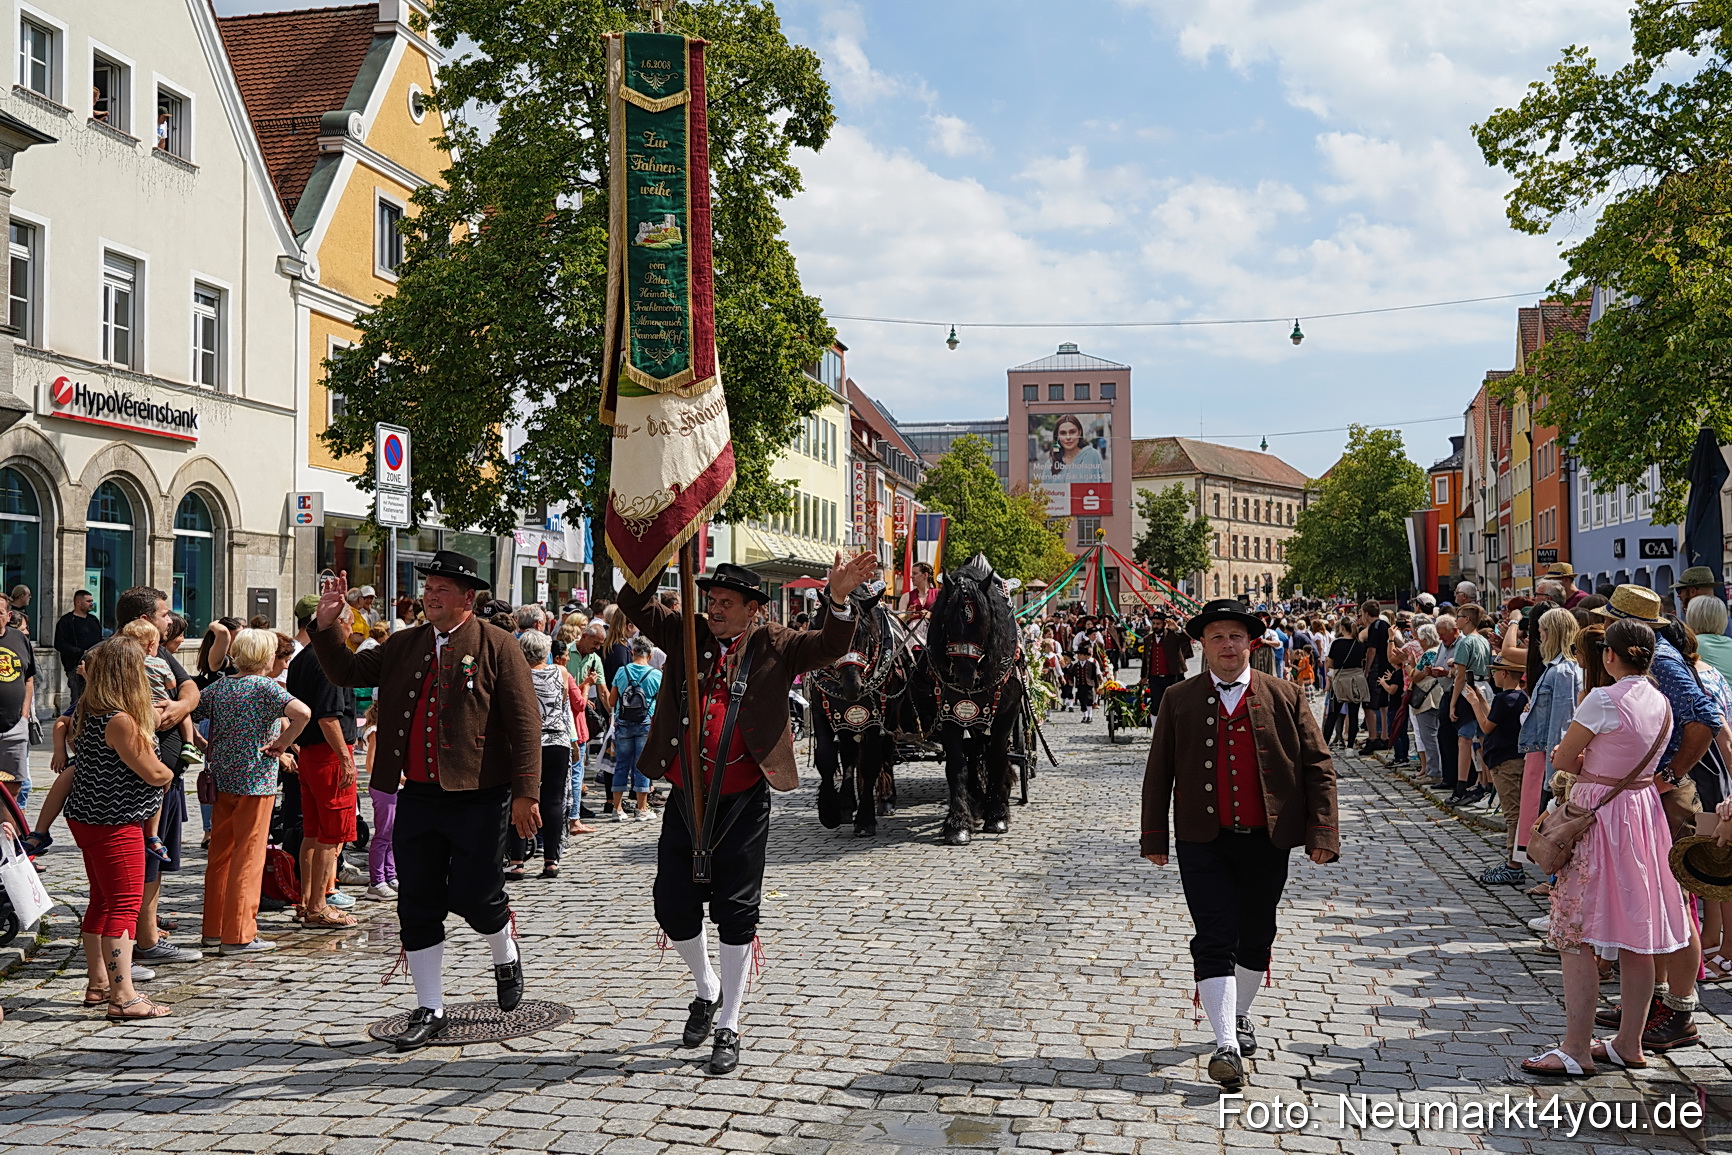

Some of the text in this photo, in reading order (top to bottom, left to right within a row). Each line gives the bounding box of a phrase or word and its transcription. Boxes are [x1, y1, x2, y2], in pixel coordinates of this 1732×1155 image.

[643, 130, 669, 148] Zur
[630, 155, 682, 174] Fahnen-
[640, 180, 672, 198] weihe
[75, 382, 198, 430] HypoVereinsbank
[386, 472, 401, 483] ZONE
[297, 495, 311, 509] EC
[1644, 542, 1670, 556] C&A
